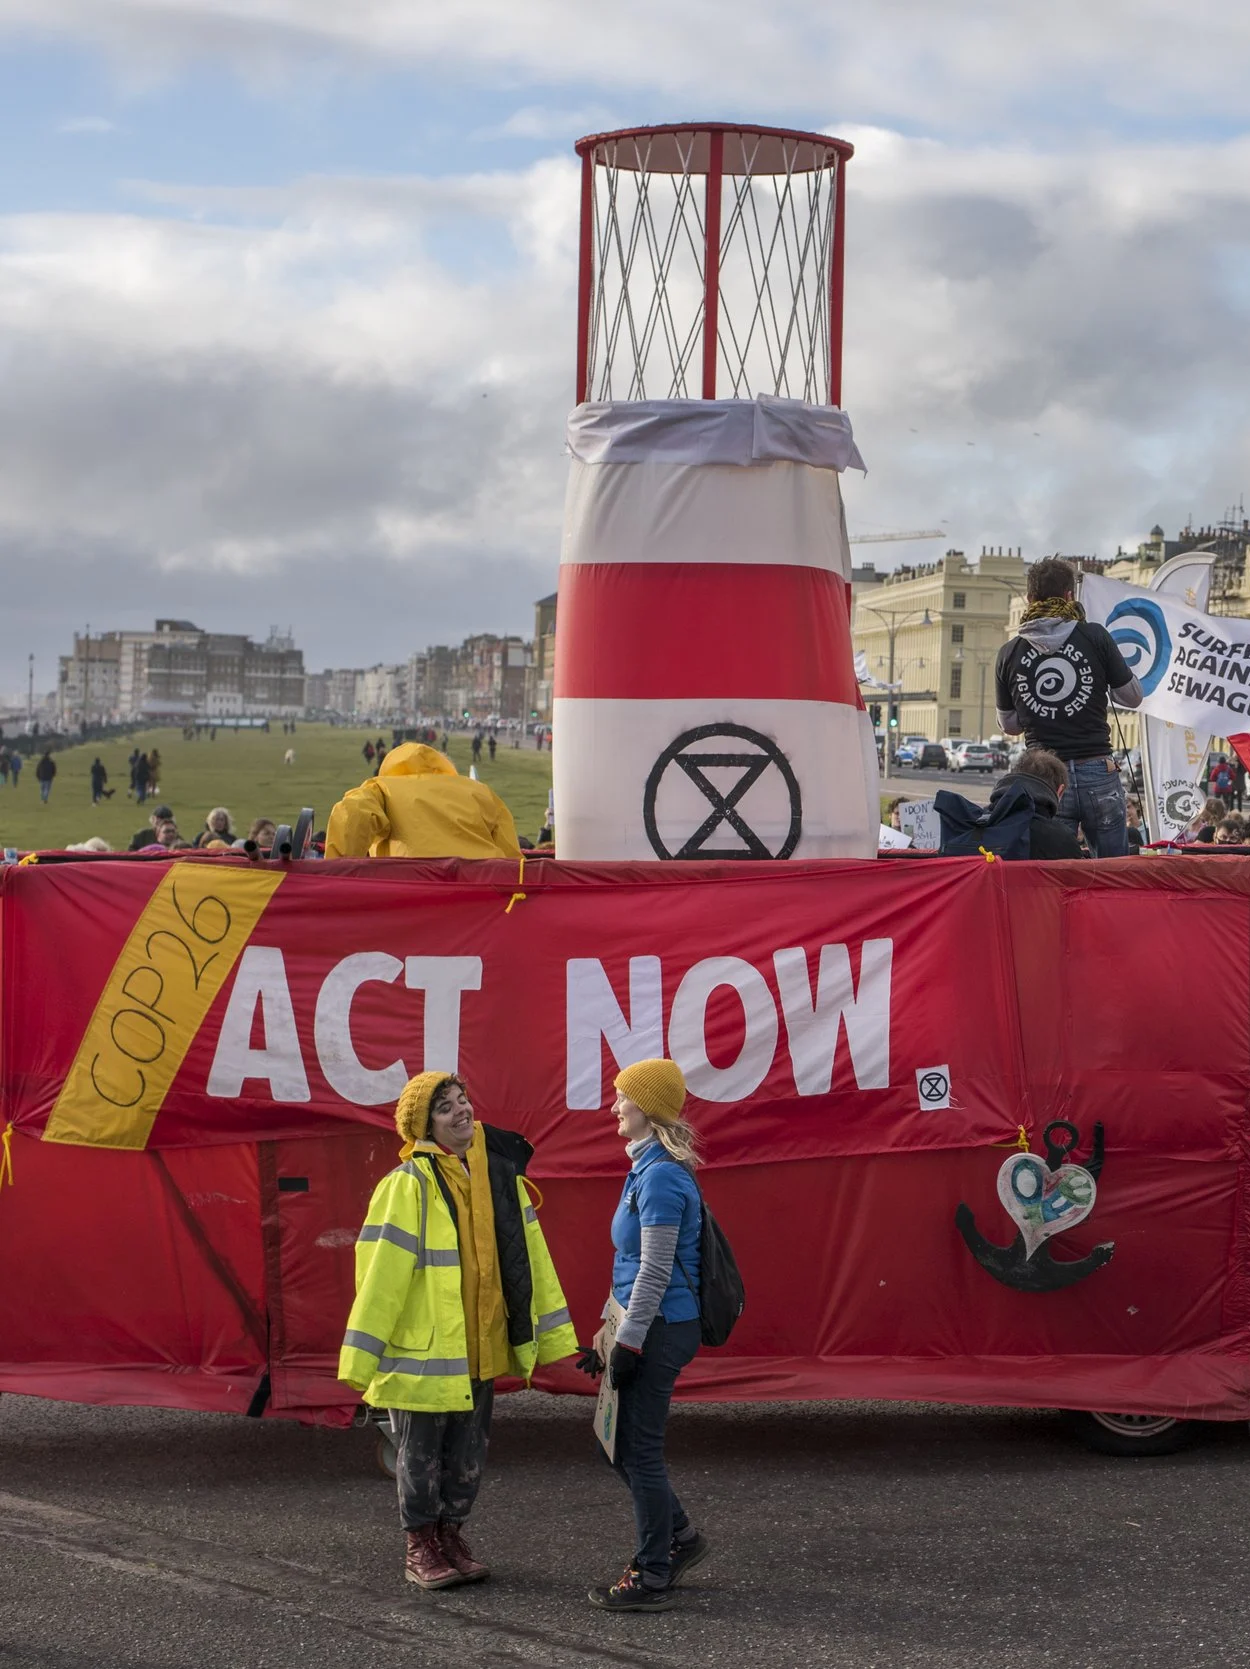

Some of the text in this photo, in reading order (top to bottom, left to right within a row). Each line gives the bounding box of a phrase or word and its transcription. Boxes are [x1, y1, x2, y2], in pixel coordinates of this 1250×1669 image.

[1016, 673, 1058, 720] AGAINST
[1064, 665, 1094, 717] SEWAGE
[90, 880, 232, 1107] COP26
[206, 937, 894, 1110] ACT NOW
